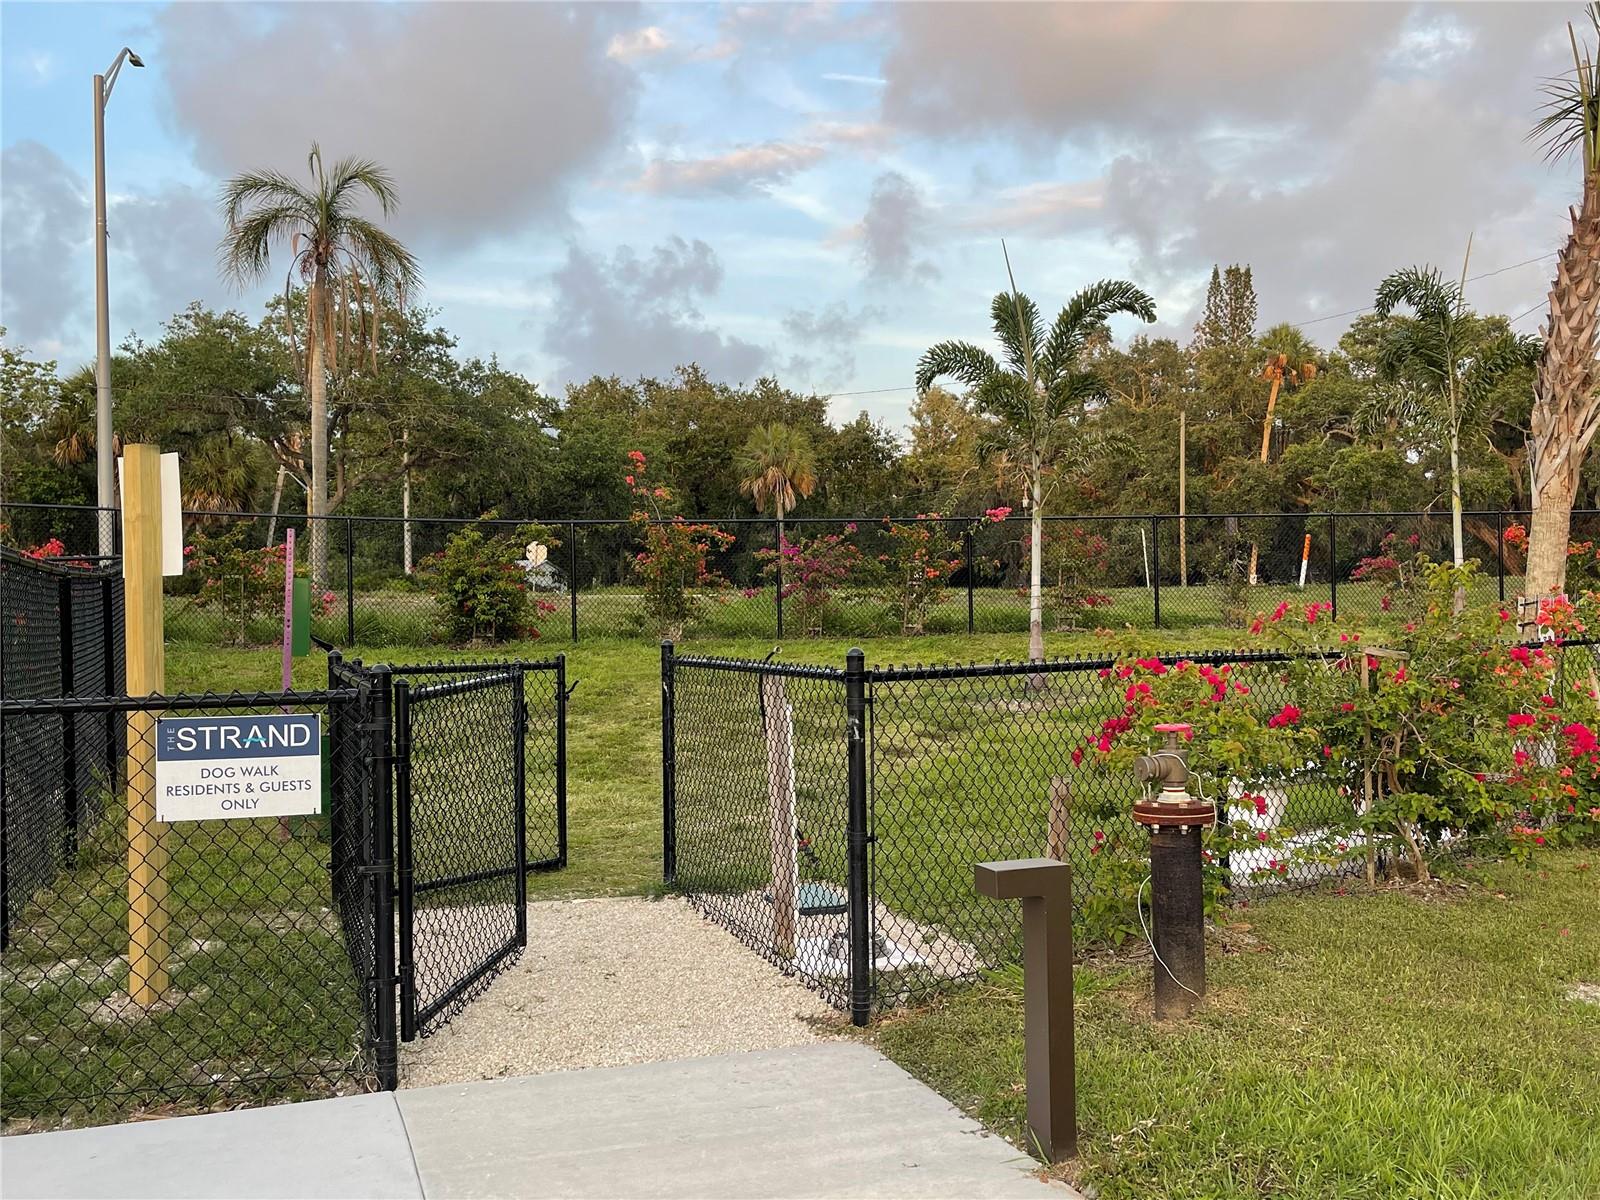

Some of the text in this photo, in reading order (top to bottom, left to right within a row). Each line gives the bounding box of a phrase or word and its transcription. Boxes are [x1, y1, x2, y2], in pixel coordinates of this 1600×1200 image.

[167, 727, 175, 751] THE
[176, 723, 311, 752] STRAND
[201, 765, 279, 779] DOG WALK
[166, 779, 312, 797] RESIDENTS & GUESTS
[221, 798, 260, 811] ONLY
